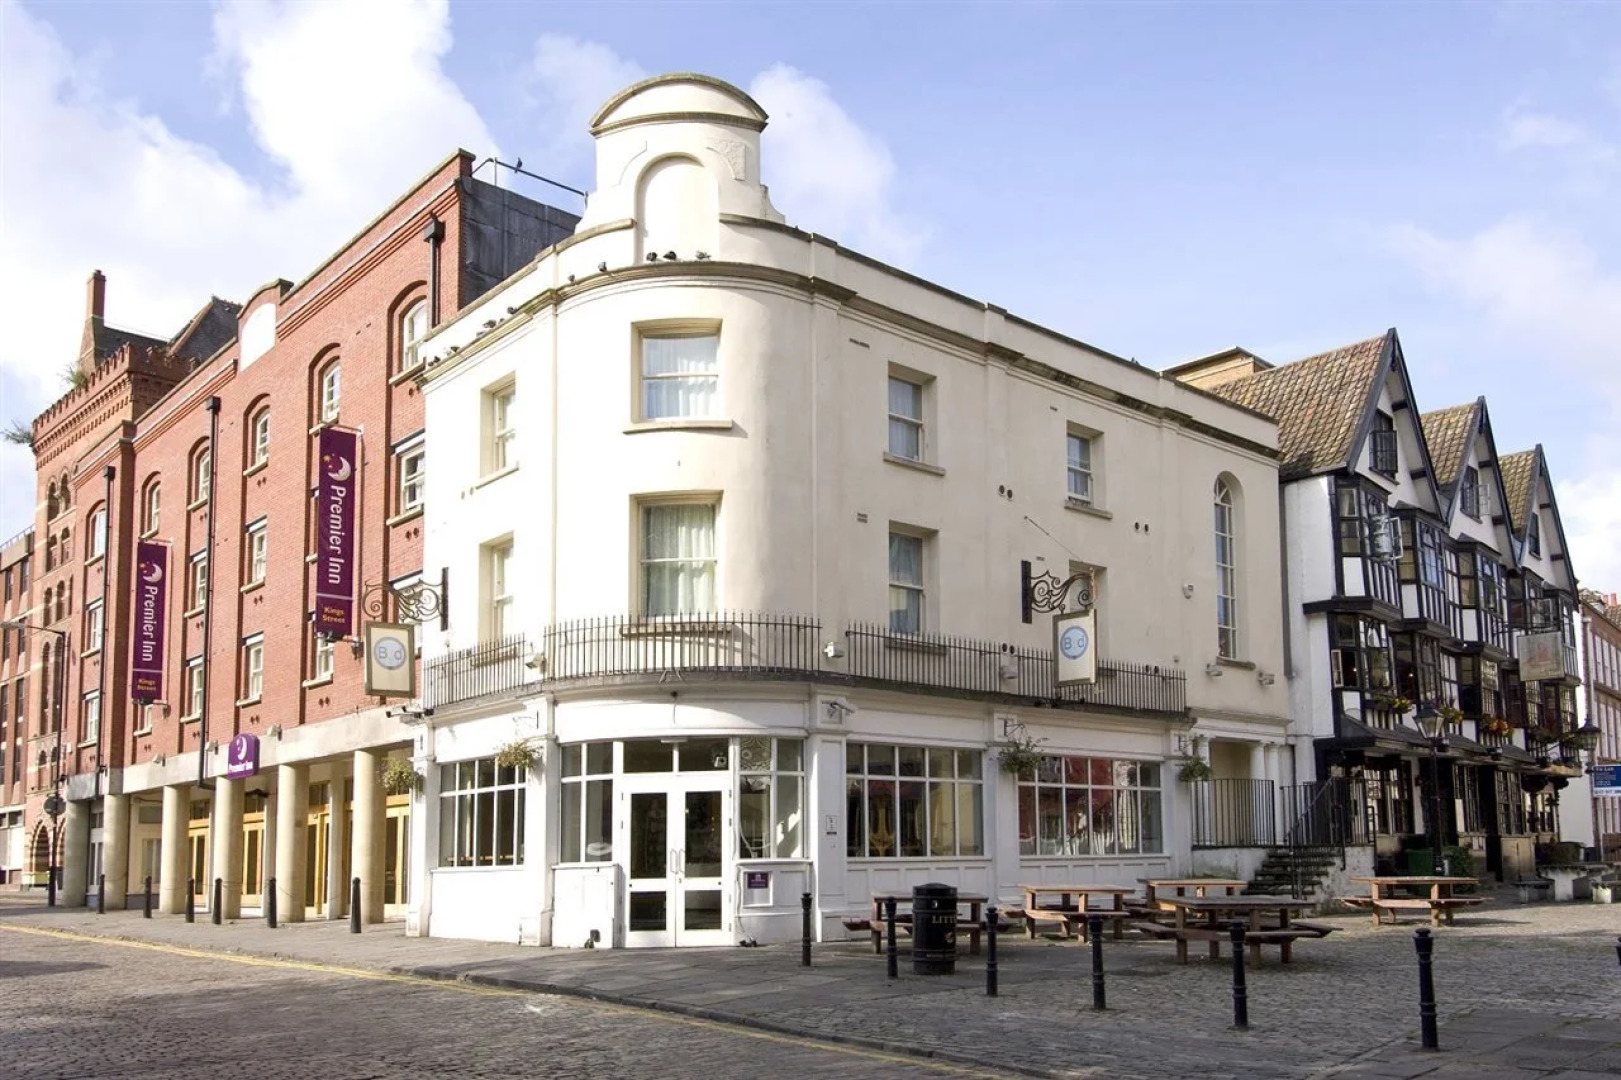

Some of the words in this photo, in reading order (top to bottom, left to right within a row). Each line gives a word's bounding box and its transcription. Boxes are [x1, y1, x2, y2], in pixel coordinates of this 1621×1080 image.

[328, 485, 347, 555] Premier
[328, 557, 345, 585] Inn
[142, 585, 158, 638] Premier
[322, 614, 345, 624] Street
[324, 607, 344, 616] Kings
[142, 641, 156, 662] Inn
